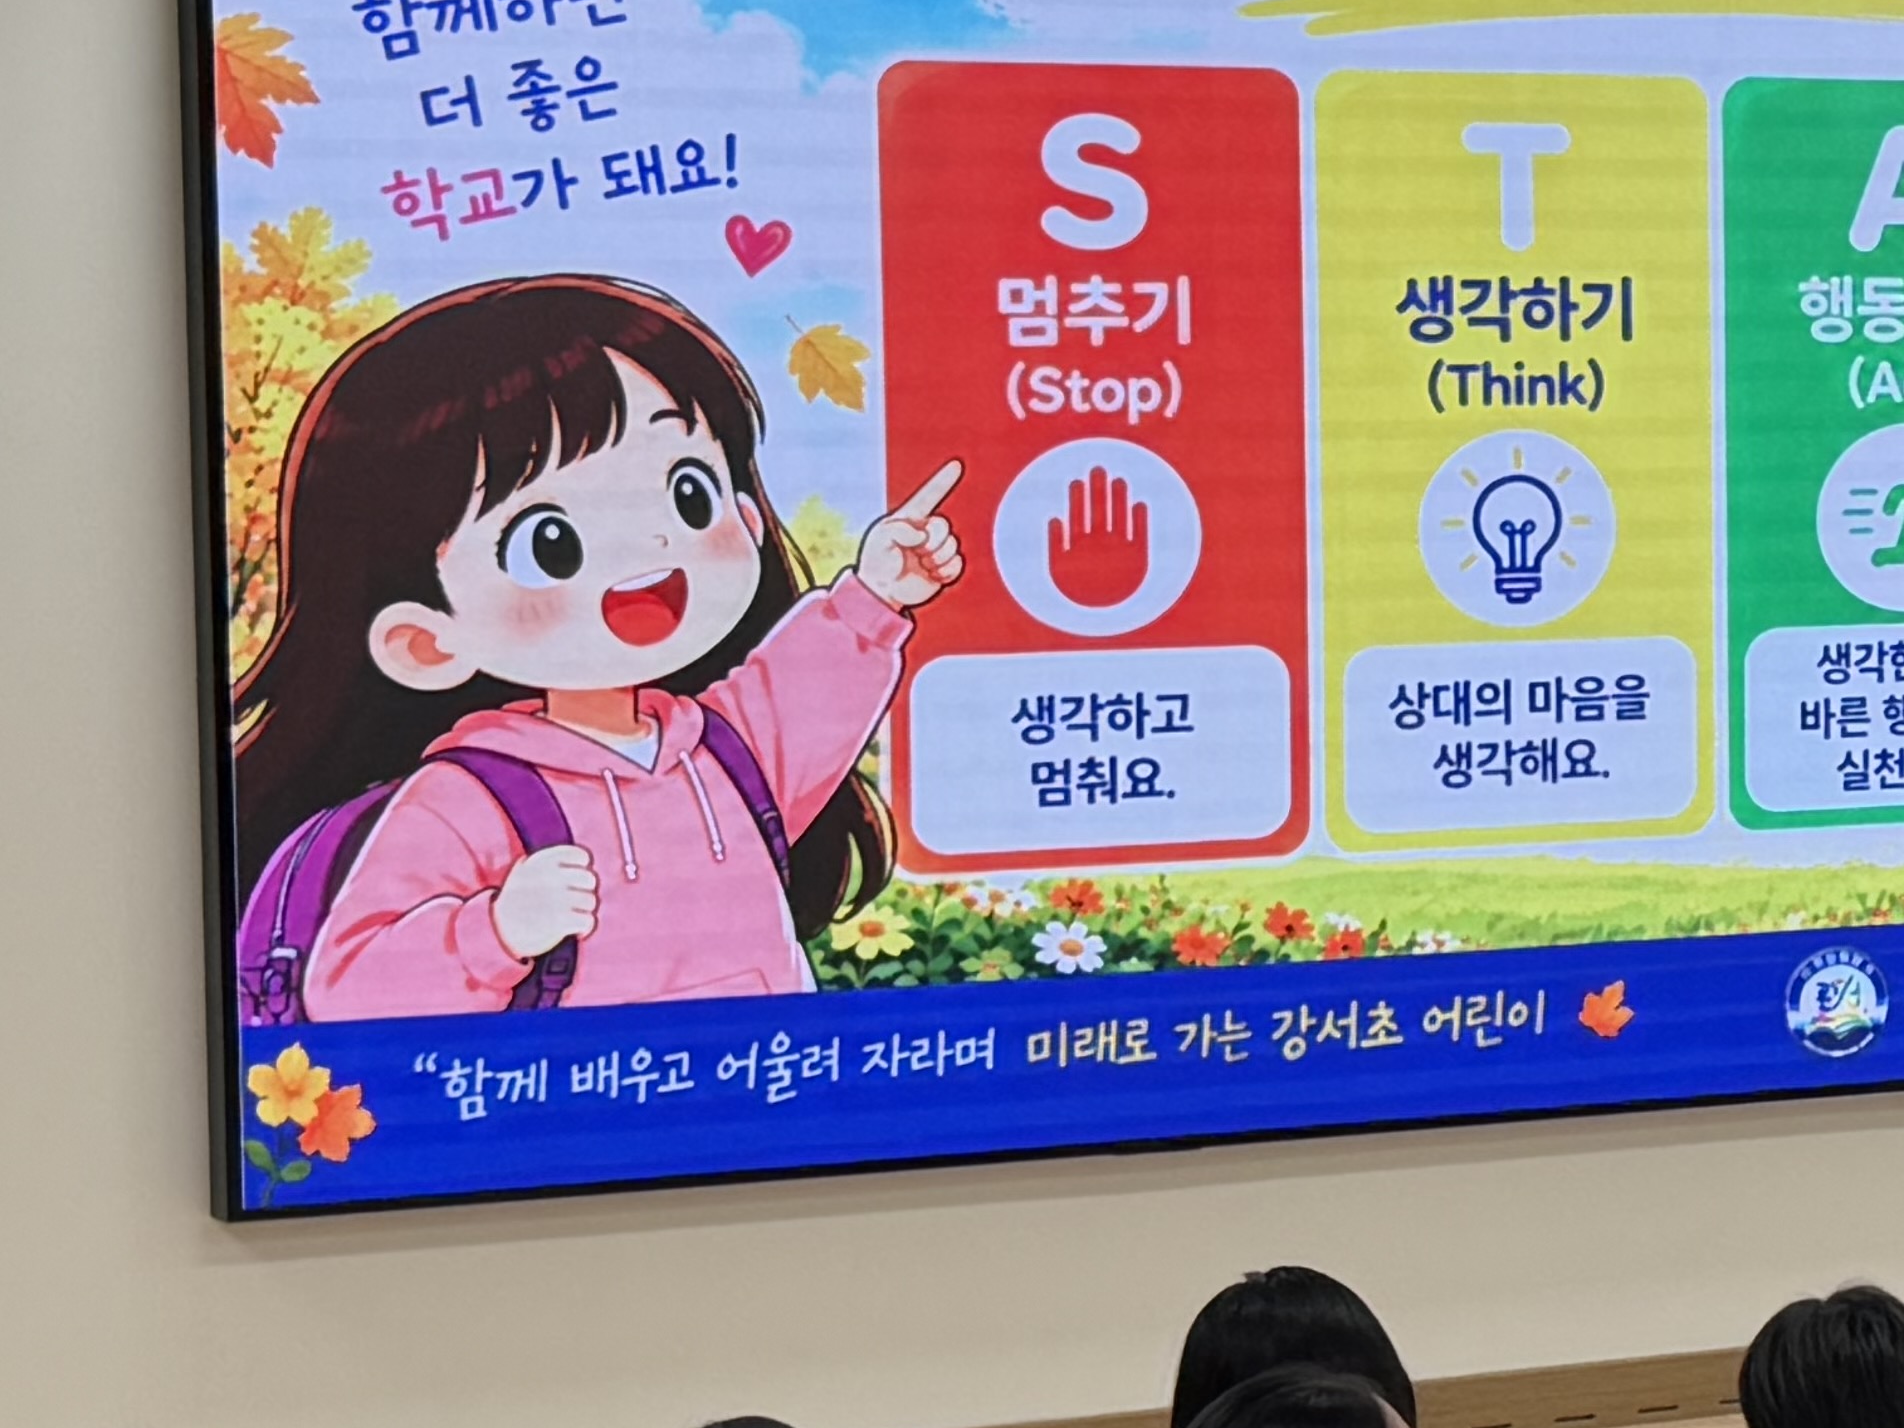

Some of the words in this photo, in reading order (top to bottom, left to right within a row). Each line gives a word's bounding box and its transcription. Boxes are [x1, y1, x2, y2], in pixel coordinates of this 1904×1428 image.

[419, 74, 483, 128] 더
[507, 55, 619, 133] 좋은
[380, 157, 579, 242] 학교가
[601, 132, 738, 200] 돼요!
[1040, 112, 1149, 251] S
[1461, 121, 1572, 253] T
[997, 274, 1191, 348] 멈추기
[1395, 274, 1633, 344] 생각하기
[1006, 360, 1182, 425] (Stop)
[1427, 357, 1604, 414] (Think)
[1011, 691, 1195, 746] 생각하고
[1388, 678, 1512, 730] 상대의
[1528, 673, 1651, 724] 마음을
[1800, 696, 1872, 740] 바른
[1030, 755, 1176, 808] 멈춰요.
[1433, 736, 1610, 790] 생각해요.
[570, 1047, 695, 1104] 배우고
[716, 1030, 840, 1104] 어울려
[861, 1027, 996, 1078] 자라며
[1027, 1018, 1158, 1068] 미래로
[1174, 1009, 1253, 1063] 가는
[1271, 1000, 1405, 1061] 강서초
[1422, 989, 1545, 1048] 어린이
